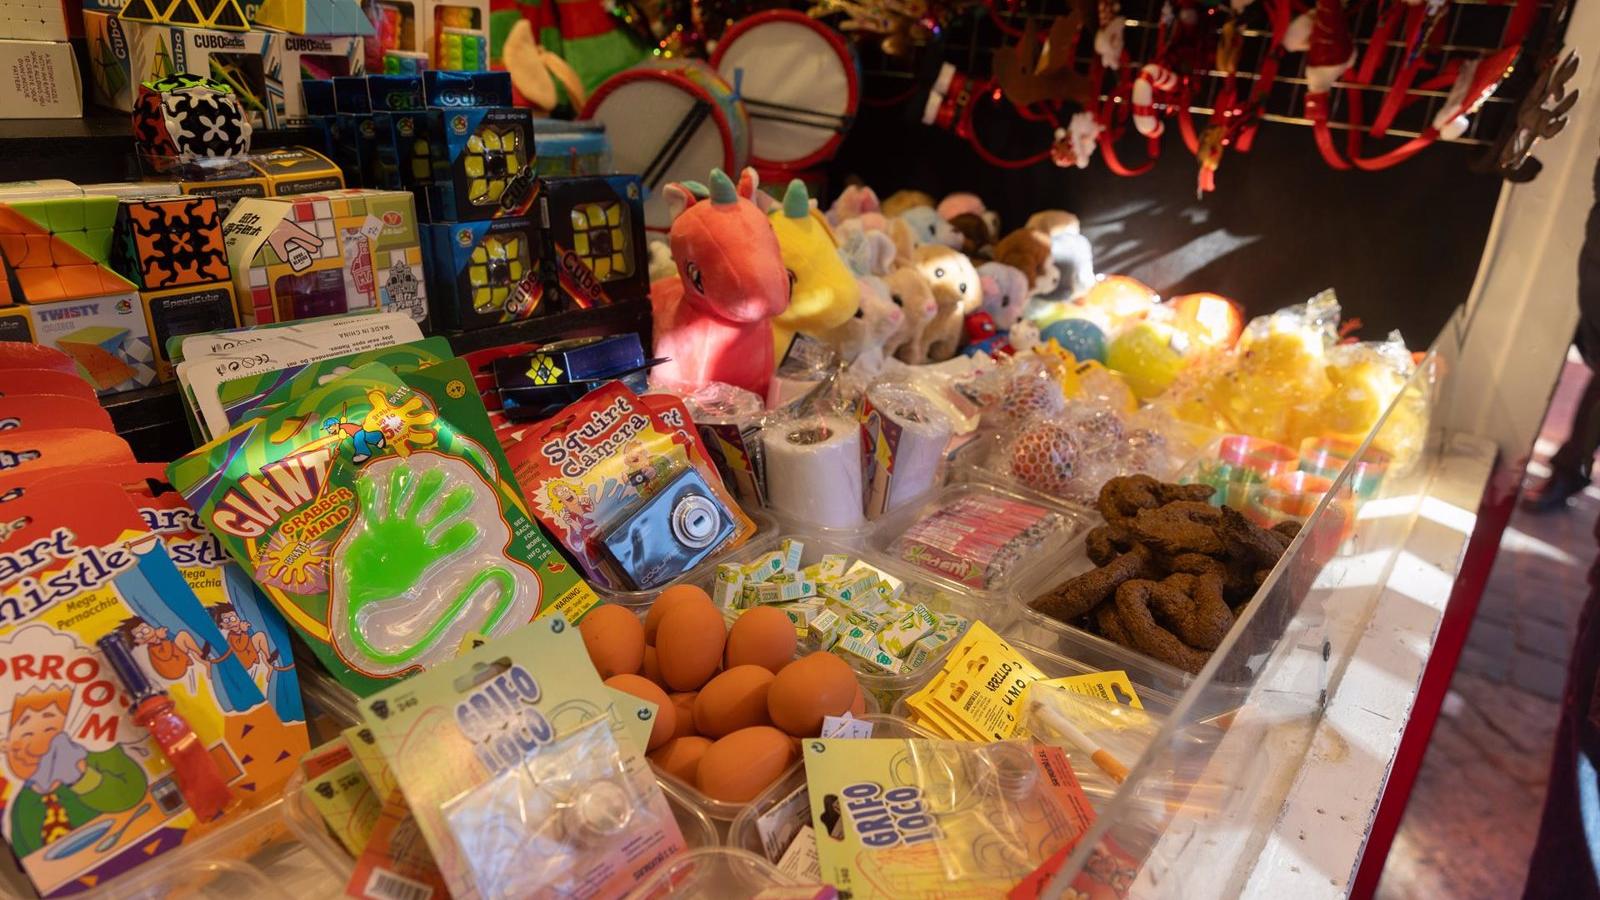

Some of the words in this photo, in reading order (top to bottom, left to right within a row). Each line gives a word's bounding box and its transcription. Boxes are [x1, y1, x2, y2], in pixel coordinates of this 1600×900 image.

[194, 34, 224, 49] CUBO
[285, 38, 313, 51] CUBO
[563, 252, 601, 299] Cube
[162, 293, 220, 308] SpeedCube
[505, 271, 539, 316] Cube
[38, 303, 100, 322] TWISTY
[338, 329, 360, 339] CHINA
[370, 324, 389, 333] MADE
[543, 398, 632, 464] Squirt
[562, 416, 645, 477] Camera
[212, 448, 331, 537] GIANT
[513, 516, 526, 527] SEE
[515, 523, 532, 536] BACK
[523, 530, 536, 541] FOR
[525, 536, 543, 550] MORE
[526, 547, 542, 560] INFO
[67, 594, 96, 613] Mega
[57, 597, 119, 630] Pernacchia
[457, 666, 539, 738] GRIFO
[843, 783, 899, 847] GRIFO
[886, 786, 940, 846] LOCO
